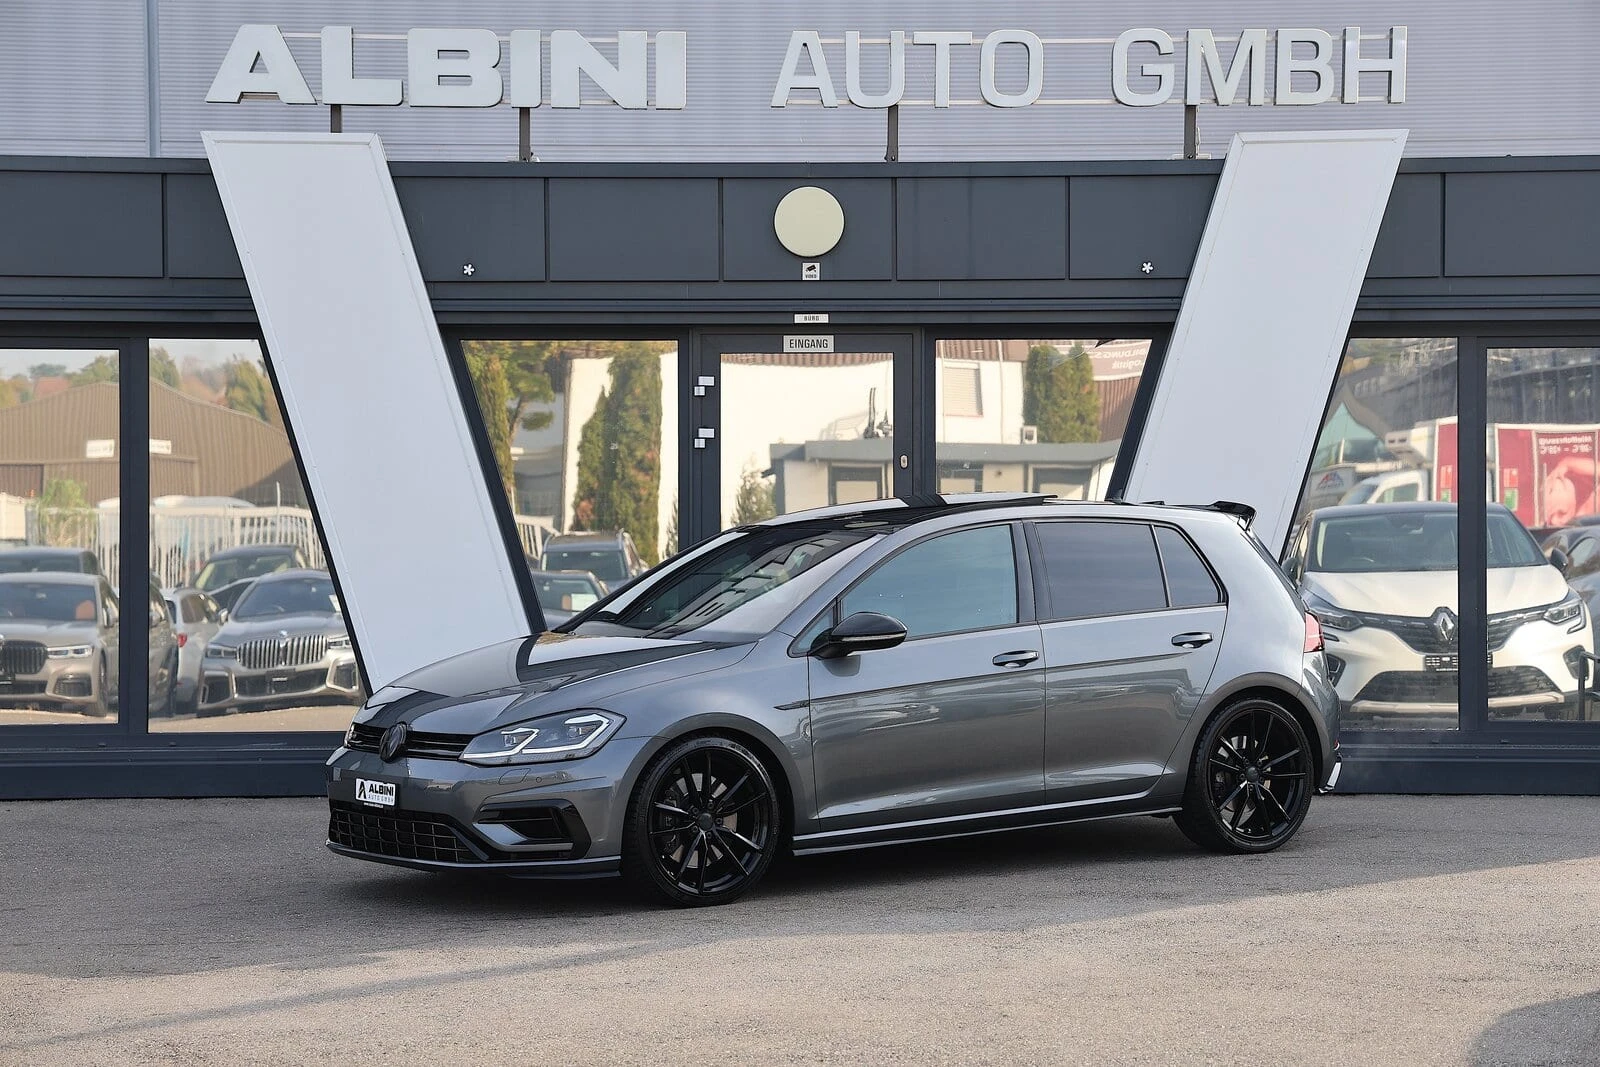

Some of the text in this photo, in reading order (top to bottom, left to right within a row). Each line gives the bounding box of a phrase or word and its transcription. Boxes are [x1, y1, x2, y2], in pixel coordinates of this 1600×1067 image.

[205, 24, 1408, 109] ALBINI AUTO GMBH
[789, 338, 829, 349] EINGANG
[368, 783, 394, 797] ALBINI
